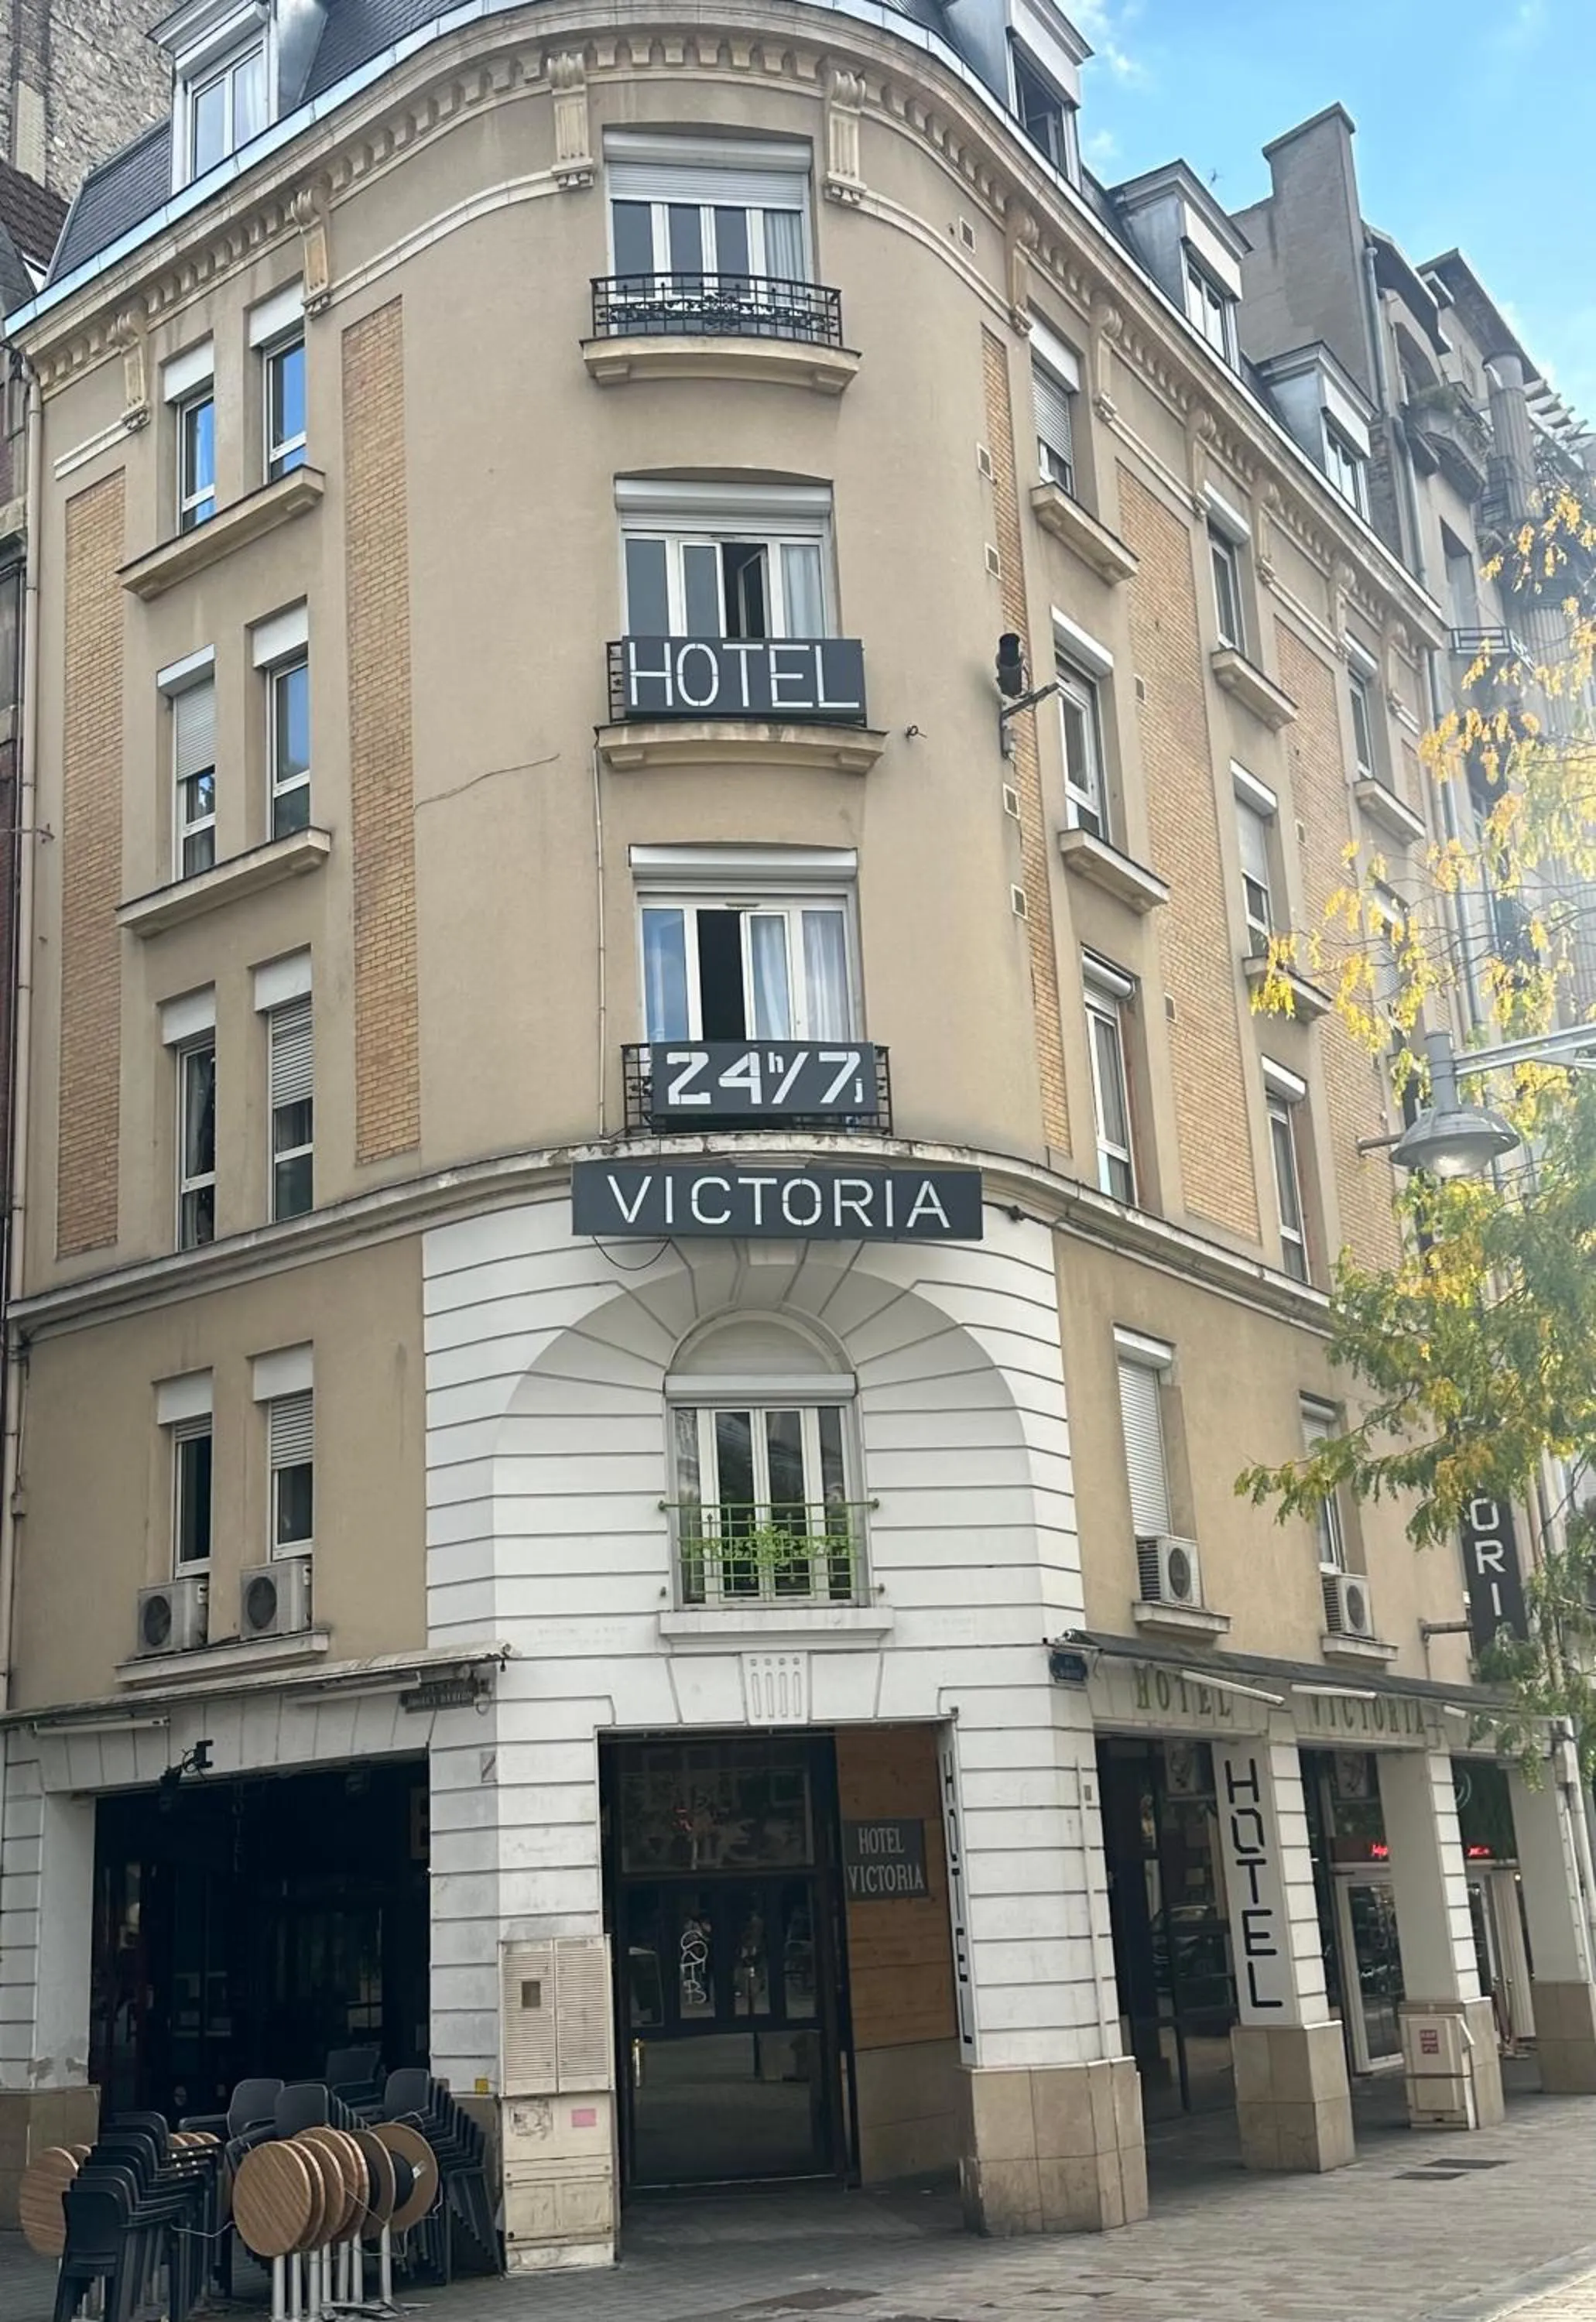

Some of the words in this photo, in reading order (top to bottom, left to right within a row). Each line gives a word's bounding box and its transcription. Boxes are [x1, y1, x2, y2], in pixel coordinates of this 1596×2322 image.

[629, 642, 859, 708] HOTEL
[607, 1175, 950, 1228] VICTORIA
[1135, 1664, 1231, 1717] HOTEL
[858, 1827, 905, 1855] HOTEL
[848, 1863, 924, 1893] VICTORIA
[944, 1751, 973, 2043] HOTEL
[1225, 1758, 1283, 2008] HOTEL
